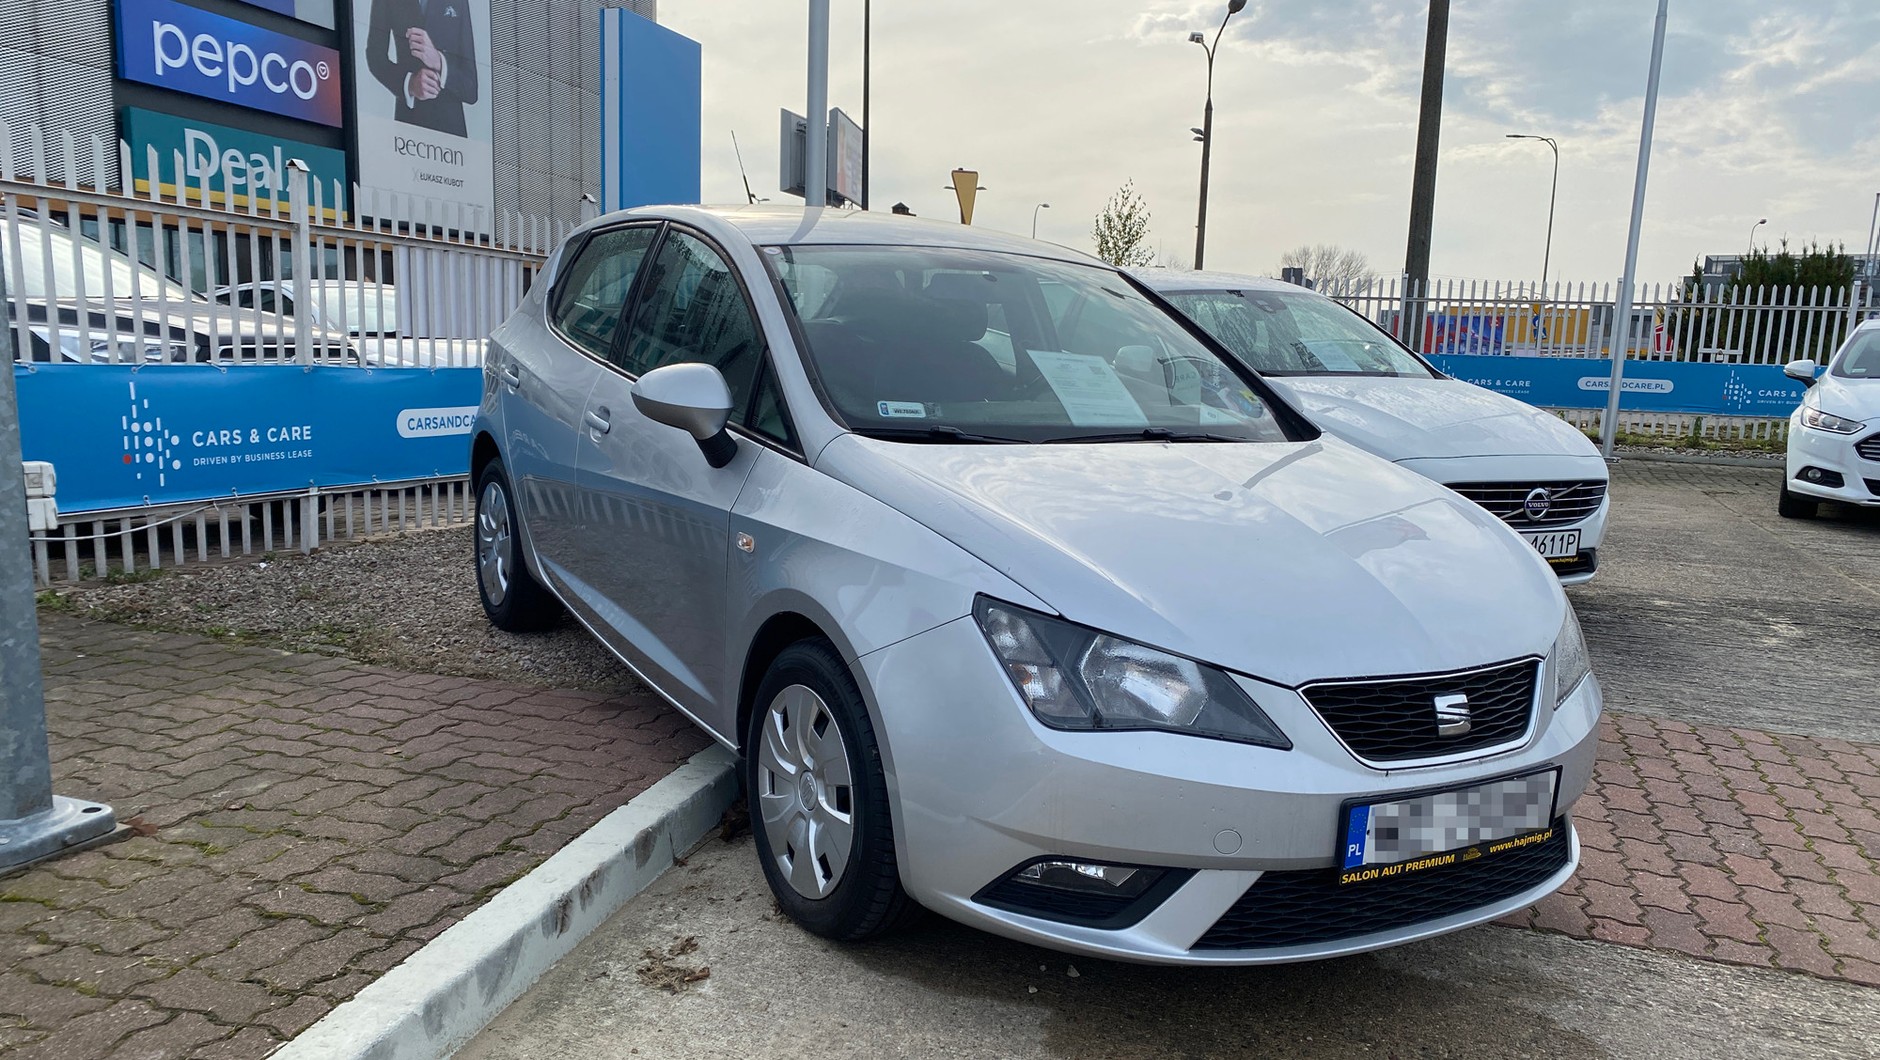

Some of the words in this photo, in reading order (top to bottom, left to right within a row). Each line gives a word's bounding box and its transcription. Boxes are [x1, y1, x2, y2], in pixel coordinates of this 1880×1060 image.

[153, 20, 317, 100] pepco
[184, 128, 290, 192] Deal
[420, 171, 443, 184] ŁUKASZ
[444, 177, 464, 188] KUBOT
[1505, 380, 1531, 388] CARE
[1585, 380, 1666, 390] CARSDCARE.PL
[1758, 389, 1787, 398] CARS
[192, 429, 242, 447] CARS
[250, 428, 260, 444] &
[267, 425, 312, 442] CARE
[193, 456, 228, 466] DRIVEN
[230, 455, 242, 464] BY
[245, 452, 285, 463] BUSINESS
[287, 449, 313, 459] LEASE
[1341, 868, 1379, 884] SALON
[1381, 864, 1403, 877] AUT
[1405, 854, 1455, 873] PREMIUM
[1489, 829, 1553, 853] www.hajmig.pl
[1348, 844, 1361, 857] PL
